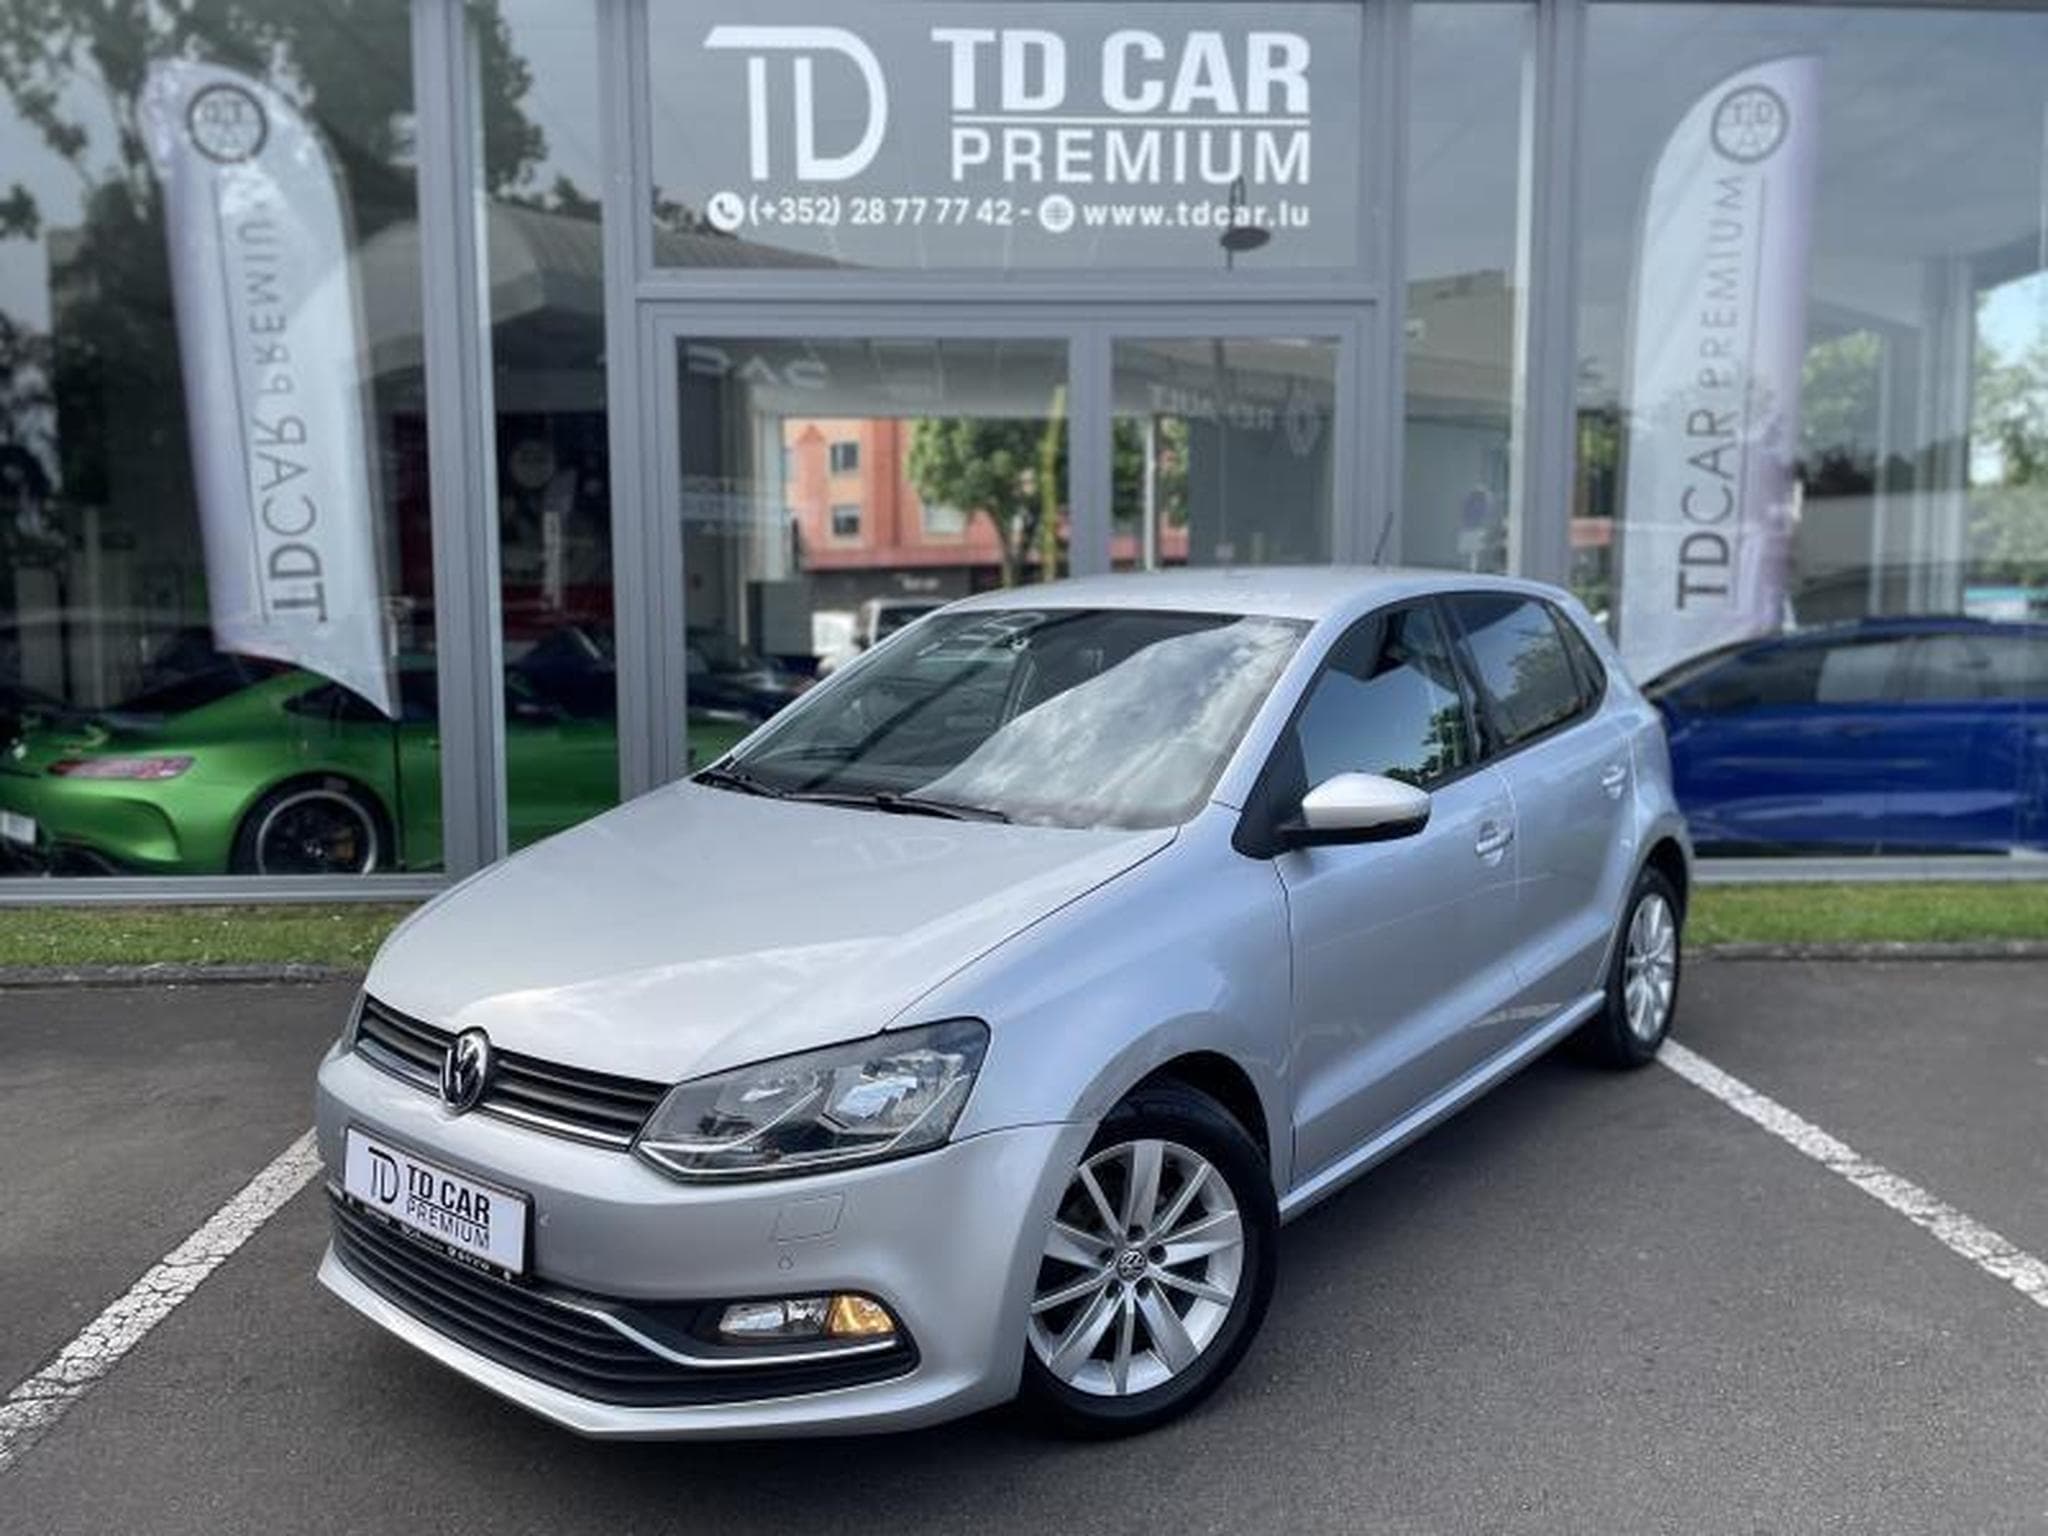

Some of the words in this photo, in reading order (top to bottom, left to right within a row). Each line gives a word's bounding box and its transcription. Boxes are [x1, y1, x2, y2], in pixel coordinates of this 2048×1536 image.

[932, 29, 1066, 112] TD
[1102, 30, 1311, 114] CAR
[704, 25, 888, 181] TD
[951, 128, 1311, 185] PREMIUM
[750, 194, 841, 227] (+352)
[850, 197, 886, 226] 28
[892, 197, 928, 226] 77
[935, 197, 970, 226] 77
[976, 197, 1014, 227] 42
[1083, 202, 1310, 228] www.tdcar.lu
[1700, 174, 1745, 390] PREMIUM
[1675, 409, 1739, 611] TDCAR
[405, 1198, 490, 1251] PREMIUM
[406, 1164, 433, 1199] TD
[440, 1181, 490, 1225] CAR
